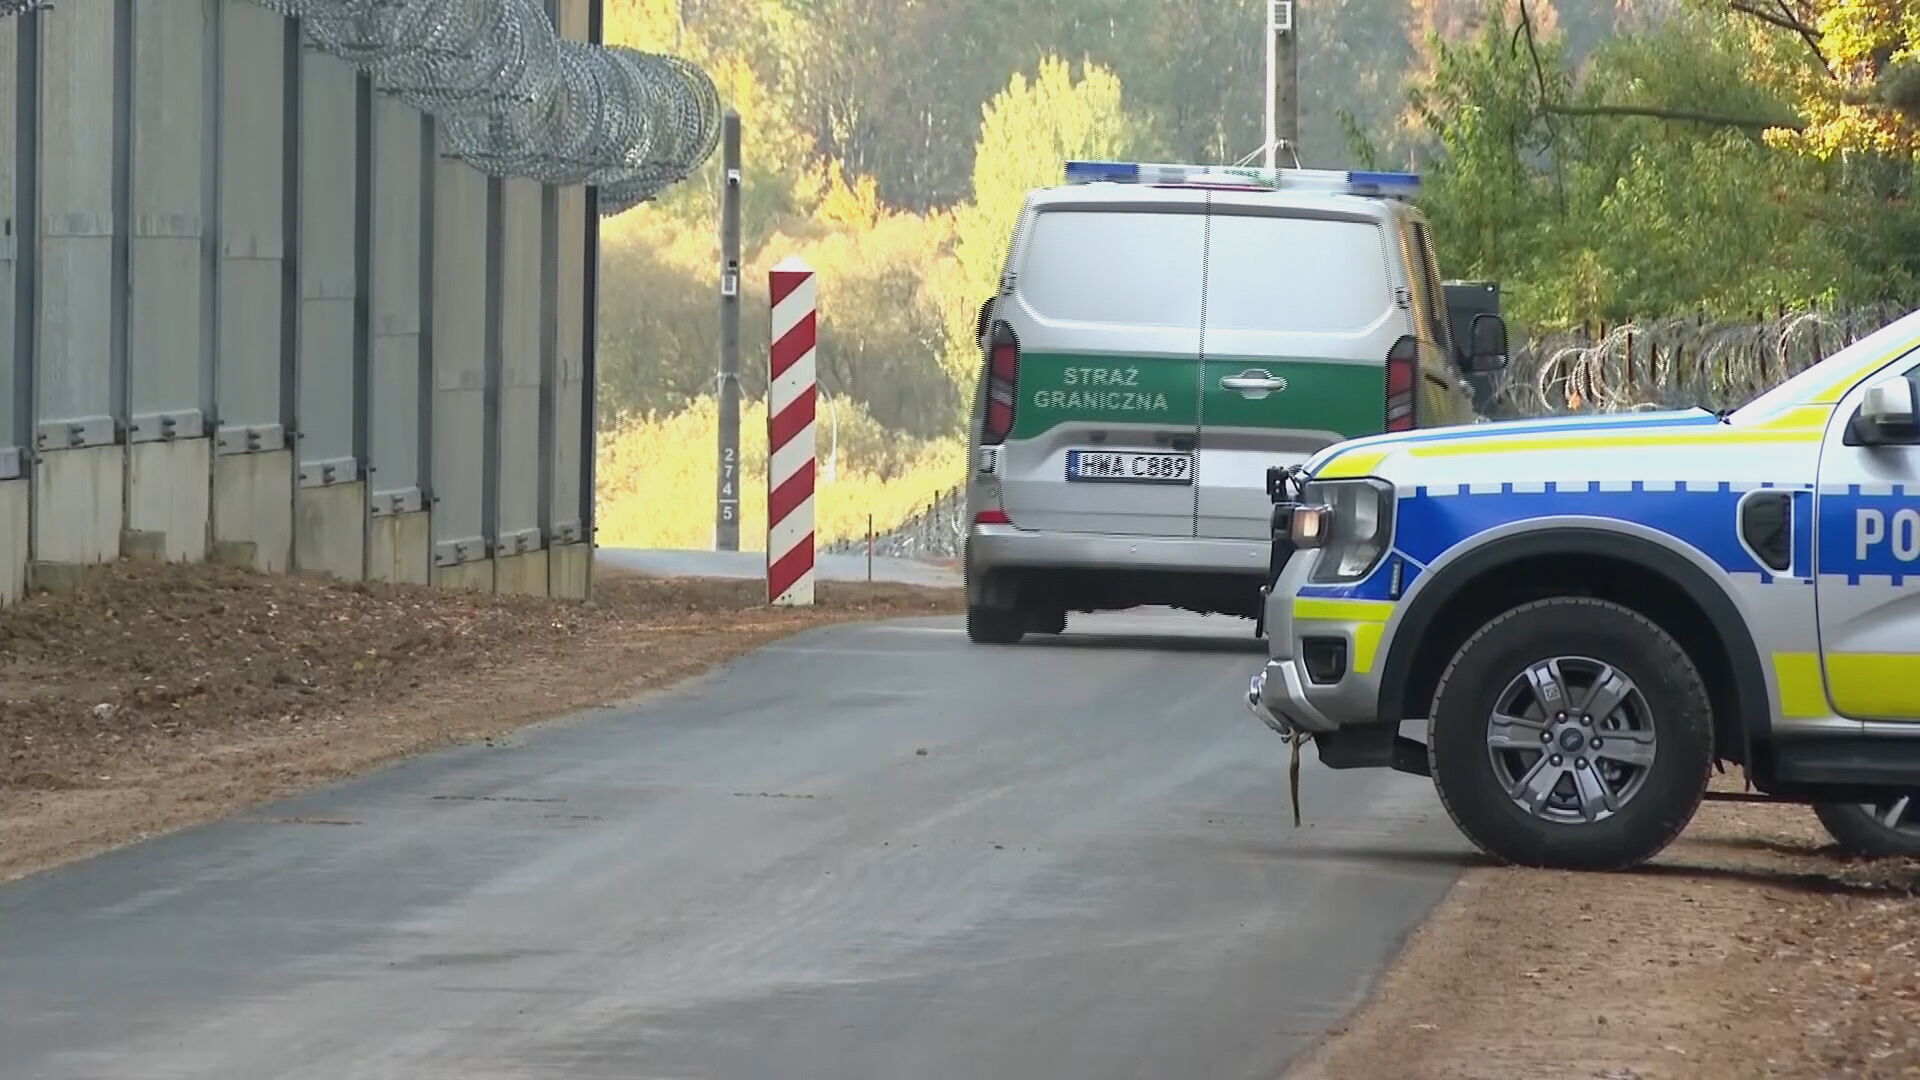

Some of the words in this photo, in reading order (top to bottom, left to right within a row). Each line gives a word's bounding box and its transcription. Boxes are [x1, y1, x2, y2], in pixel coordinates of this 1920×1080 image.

[1063, 364, 1139, 386] STRAŻ
[1033, 390, 1168, 410] GRANICZNA
[1082, 454, 1125, 476] HWA
[1131, 456, 1188, 478] C889
[1855, 508, 1920, 562] PO
